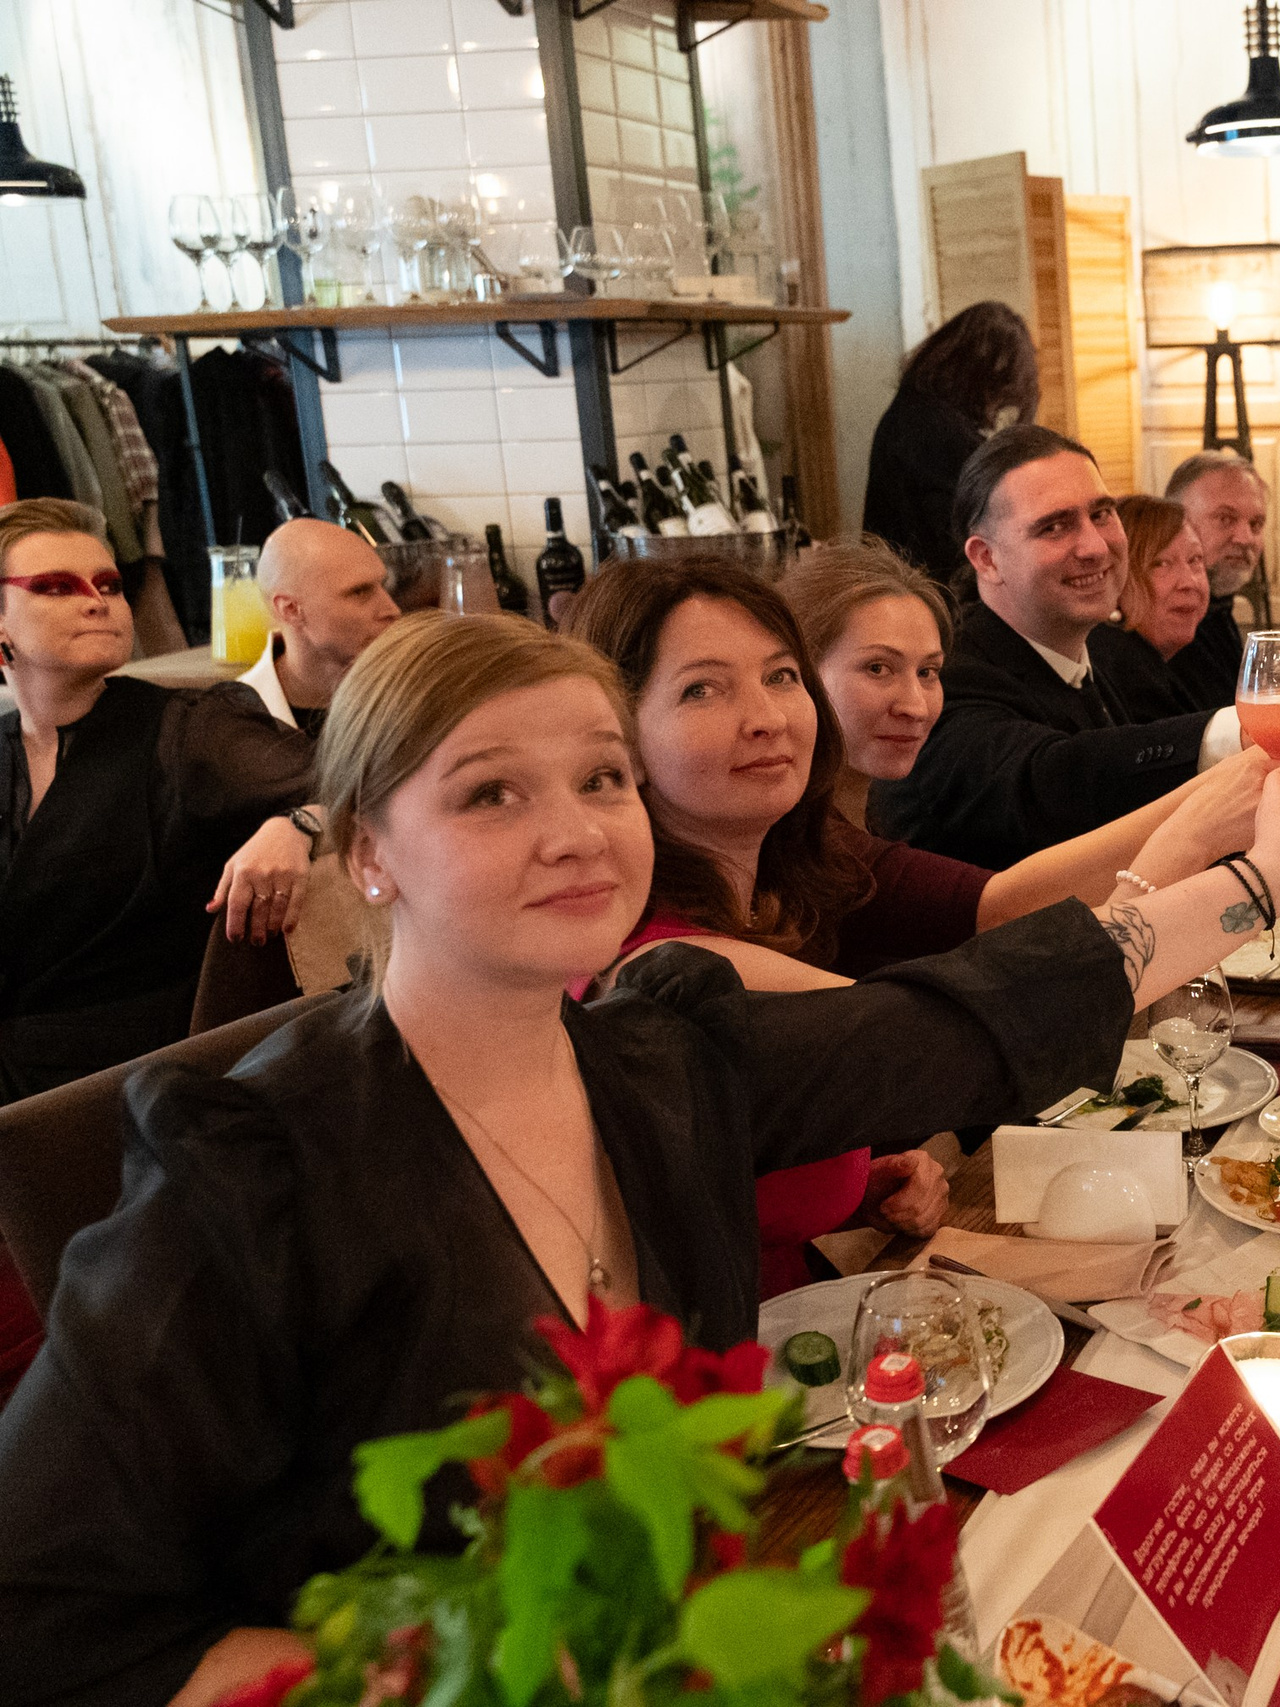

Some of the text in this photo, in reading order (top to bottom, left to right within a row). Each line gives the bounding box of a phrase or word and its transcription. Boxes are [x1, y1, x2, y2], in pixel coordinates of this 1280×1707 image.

[1207, 1436, 1219, 1454] вы
[1218, 1402, 1244, 1437] можете
[1176, 1499, 1196, 1529] фото
[1194, 1488, 1203, 1501] и
[1201, 1457, 1224, 1490] видео
[1223, 1441, 1234, 1458] со
[1233, 1410, 1257, 1442] своих
[1182, 1543, 1204, 1578] могли
[1203, 1510, 1226, 1544] сразу
[1224, 1447, 1268, 1510] насладиться
[1236, 1500, 1248, 1520] об
[1247, 1476, 1266, 1503] этом
[1237, 1500, 1265, 1546] вечере!
